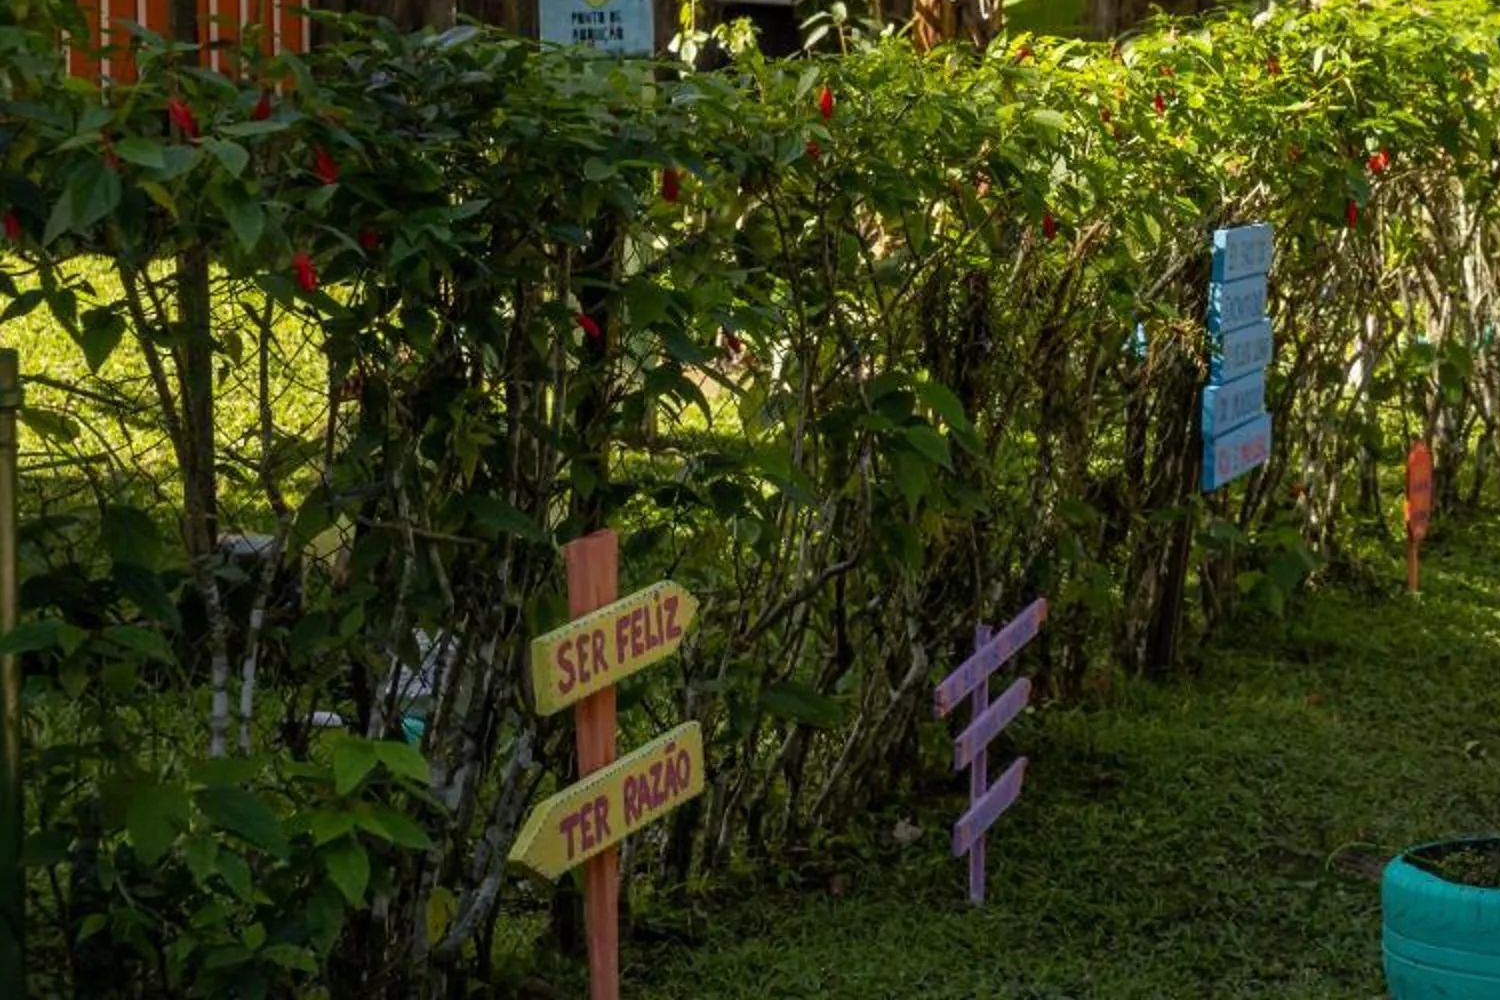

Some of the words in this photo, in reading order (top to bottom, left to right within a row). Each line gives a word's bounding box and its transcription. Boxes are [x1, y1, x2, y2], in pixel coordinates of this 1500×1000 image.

[557, 628, 609, 695] SER
[559, 795, 612, 862] TER
[622, 743, 692, 827] RAZÃO
